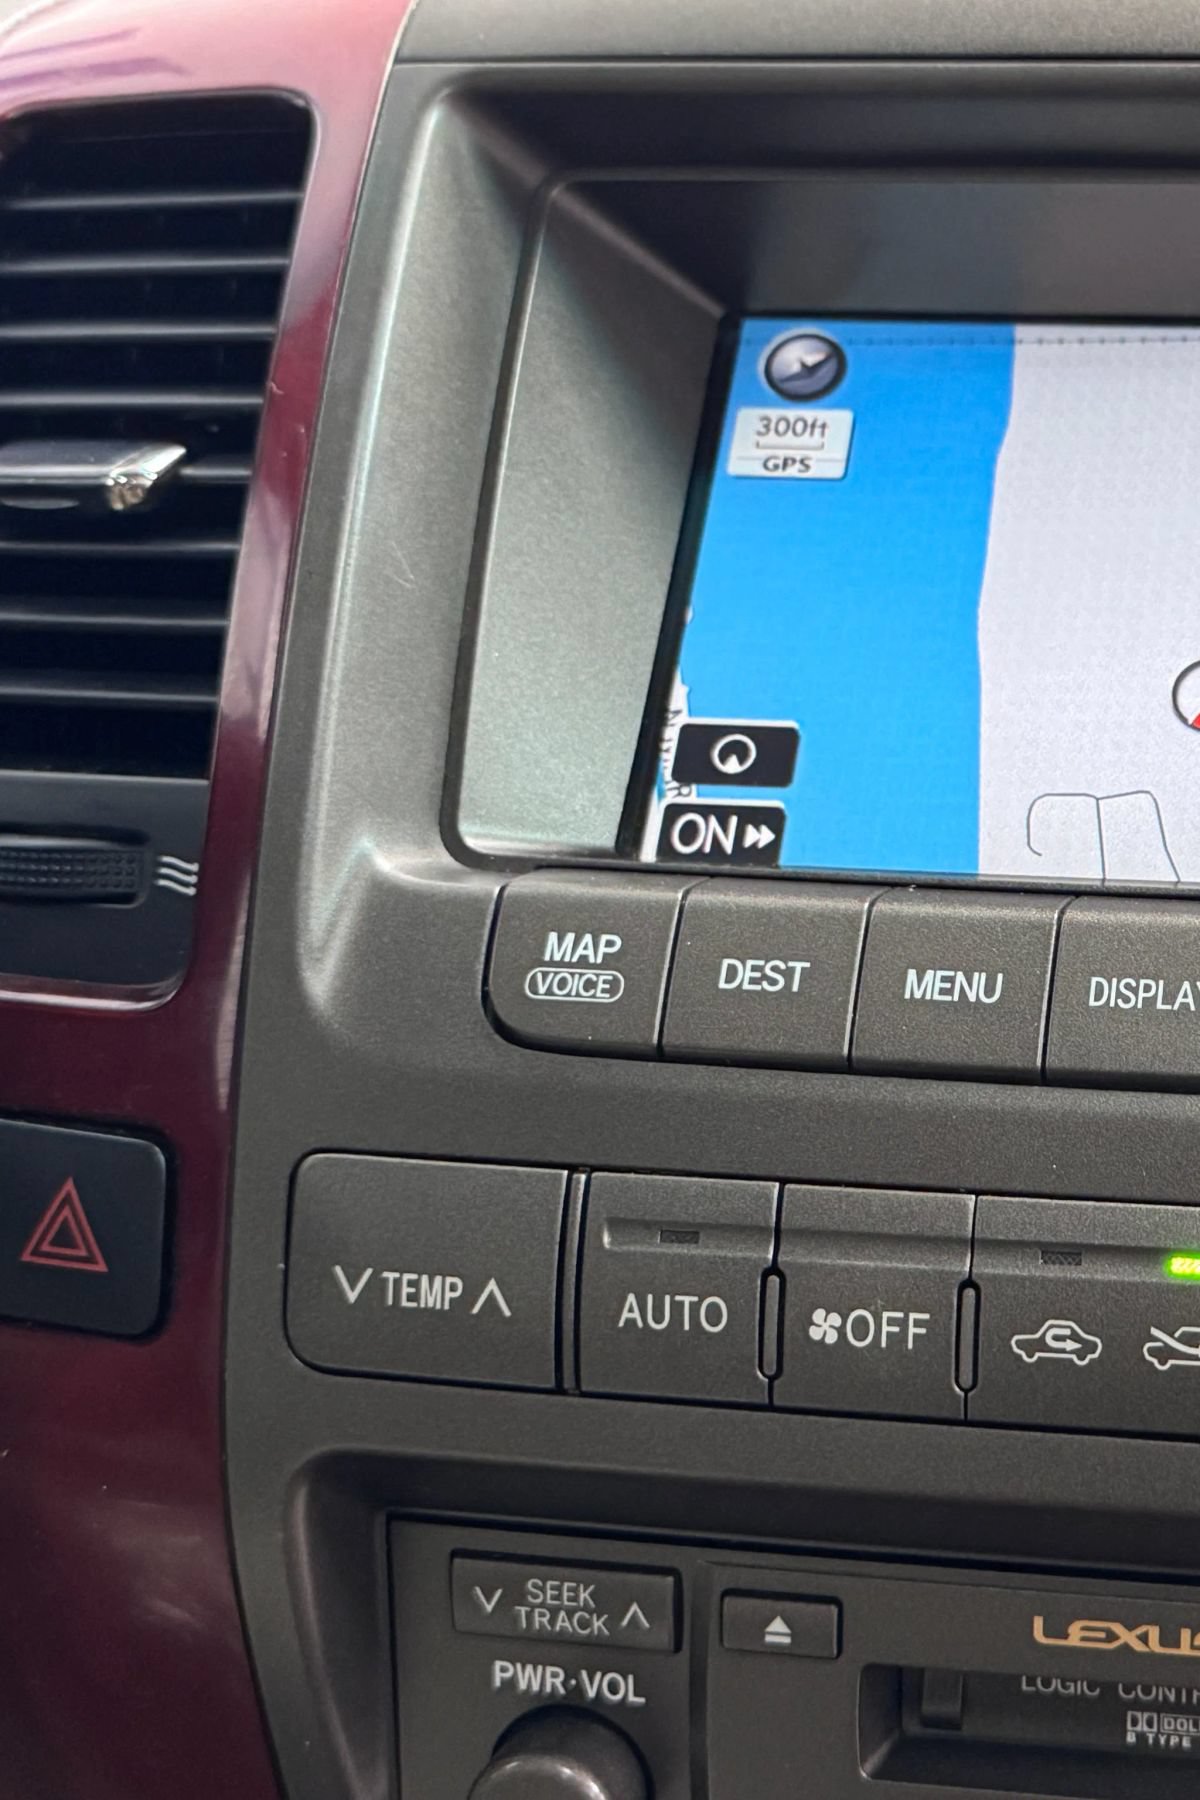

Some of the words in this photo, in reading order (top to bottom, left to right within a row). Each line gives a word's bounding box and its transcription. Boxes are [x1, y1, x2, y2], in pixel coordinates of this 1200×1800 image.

[755, 416, 828, 439] 300ft
[762, 457, 813, 474] GPS
[671, 813, 738, 855] ON
[544, 932, 622, 962] MAP
[536, 973, 612, 999] VOICE
[718, 959, 811, 993] DEST
[903, 969, 1004, 1004] MENU
[381, 1271, 463, 1311] TEMP
[617, 1293, 728, 1334] AUTO
[845, 1309, 931, 1350] OFF
[526, 1577, 596, 1608] SEEK
[515, 1606, 610, 1636] TRACK
[1147, 1735, 1191, 1749] TYPE
